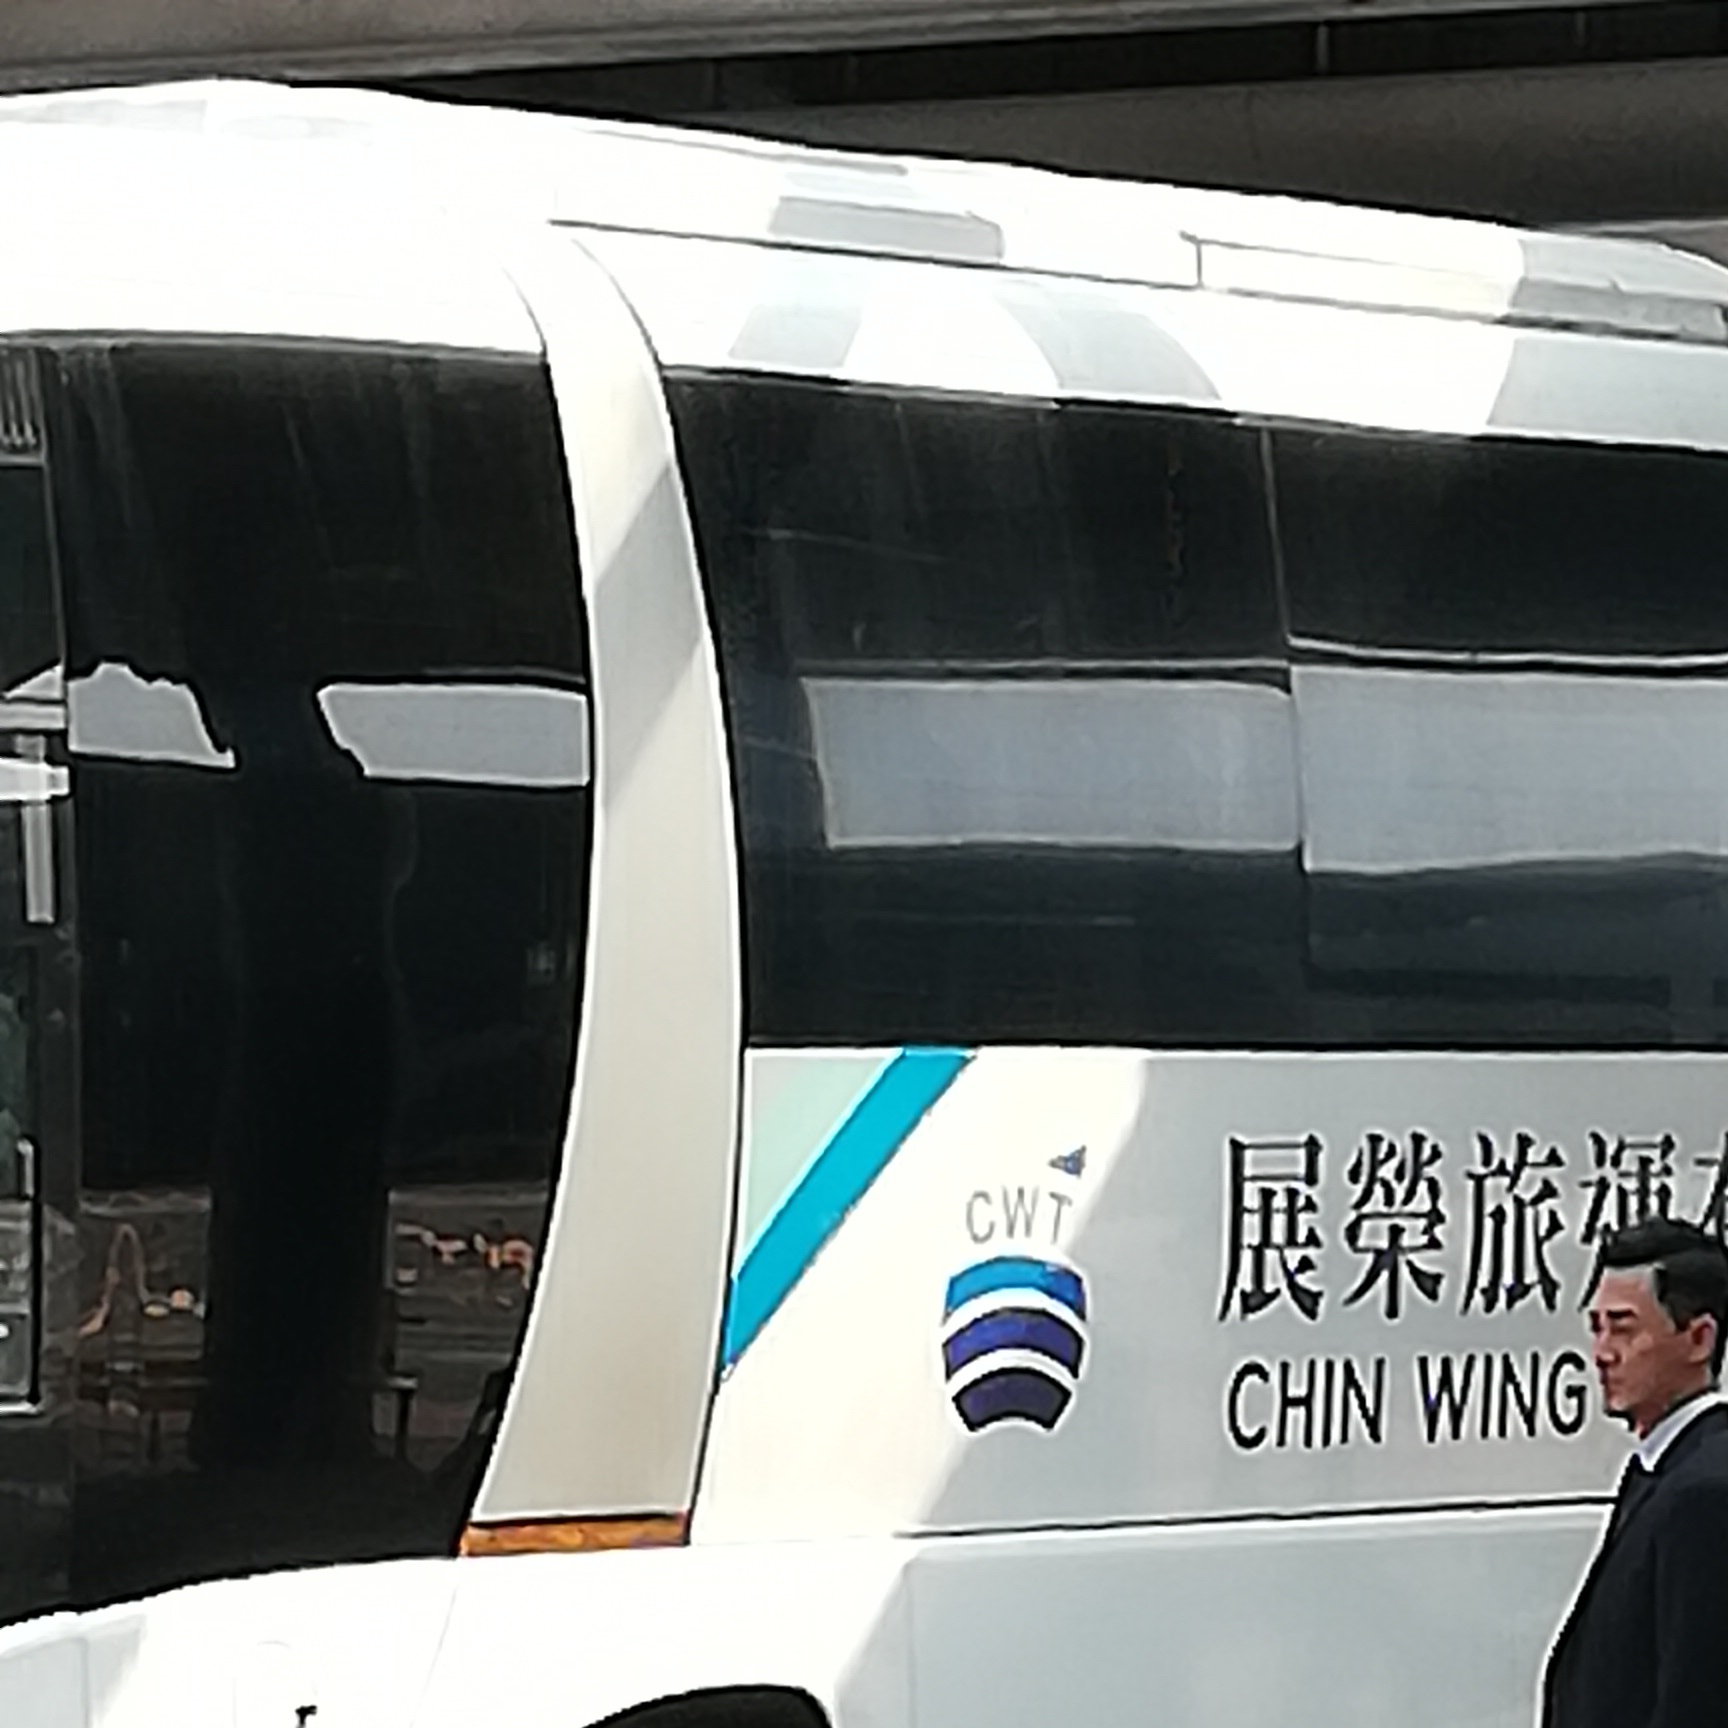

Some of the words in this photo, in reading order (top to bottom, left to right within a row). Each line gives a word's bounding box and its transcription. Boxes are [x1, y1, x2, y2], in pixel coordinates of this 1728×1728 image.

[965, 1186, 1074, 1244] CWT
[1227, 1356, 1385, 1449] CHIN
[1417, 1351, 1587, 1444] WING
